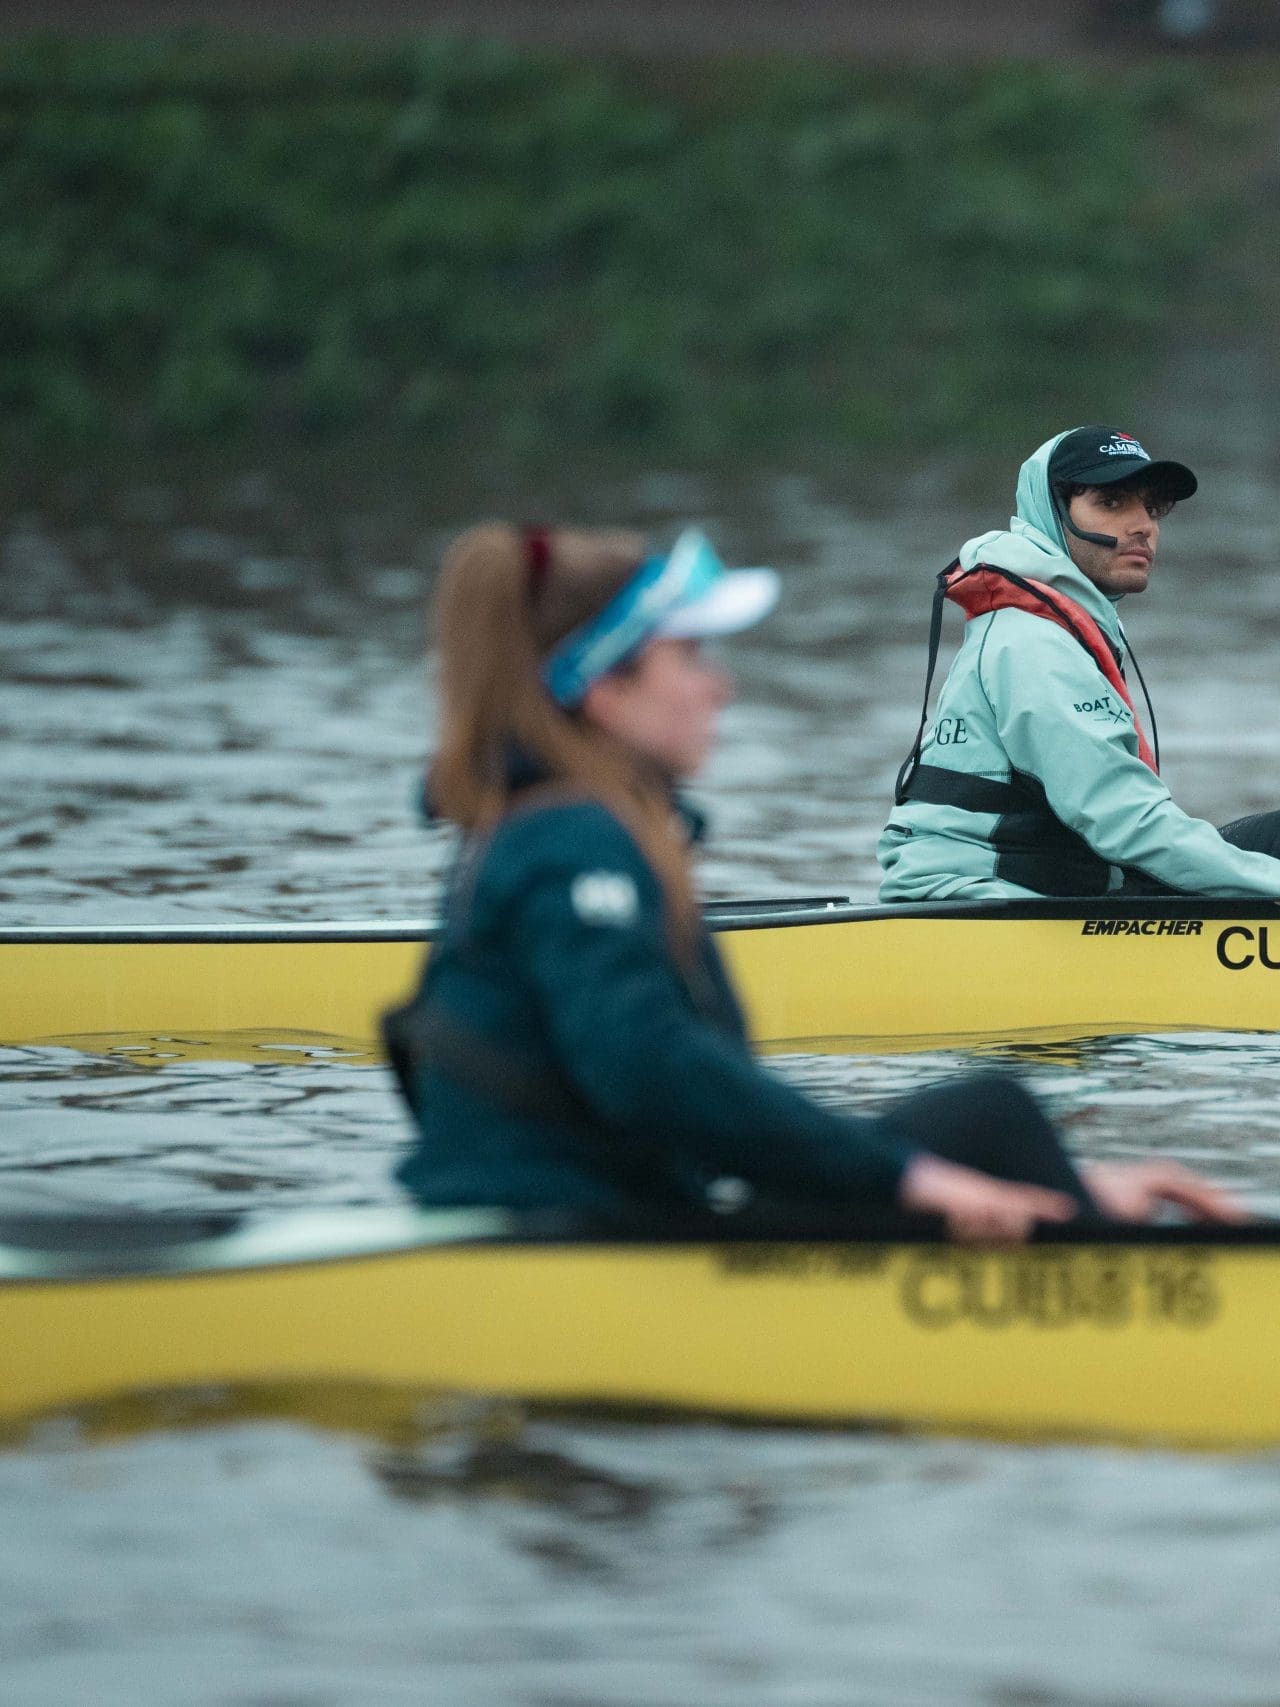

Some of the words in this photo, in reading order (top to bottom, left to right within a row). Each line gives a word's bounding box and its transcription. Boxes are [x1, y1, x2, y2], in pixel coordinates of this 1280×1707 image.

[1073, 696, 1110, 713] BOAT
[935, 718, 968, 746] GE
[1081, 920, 1203, 936] EMPACHER
